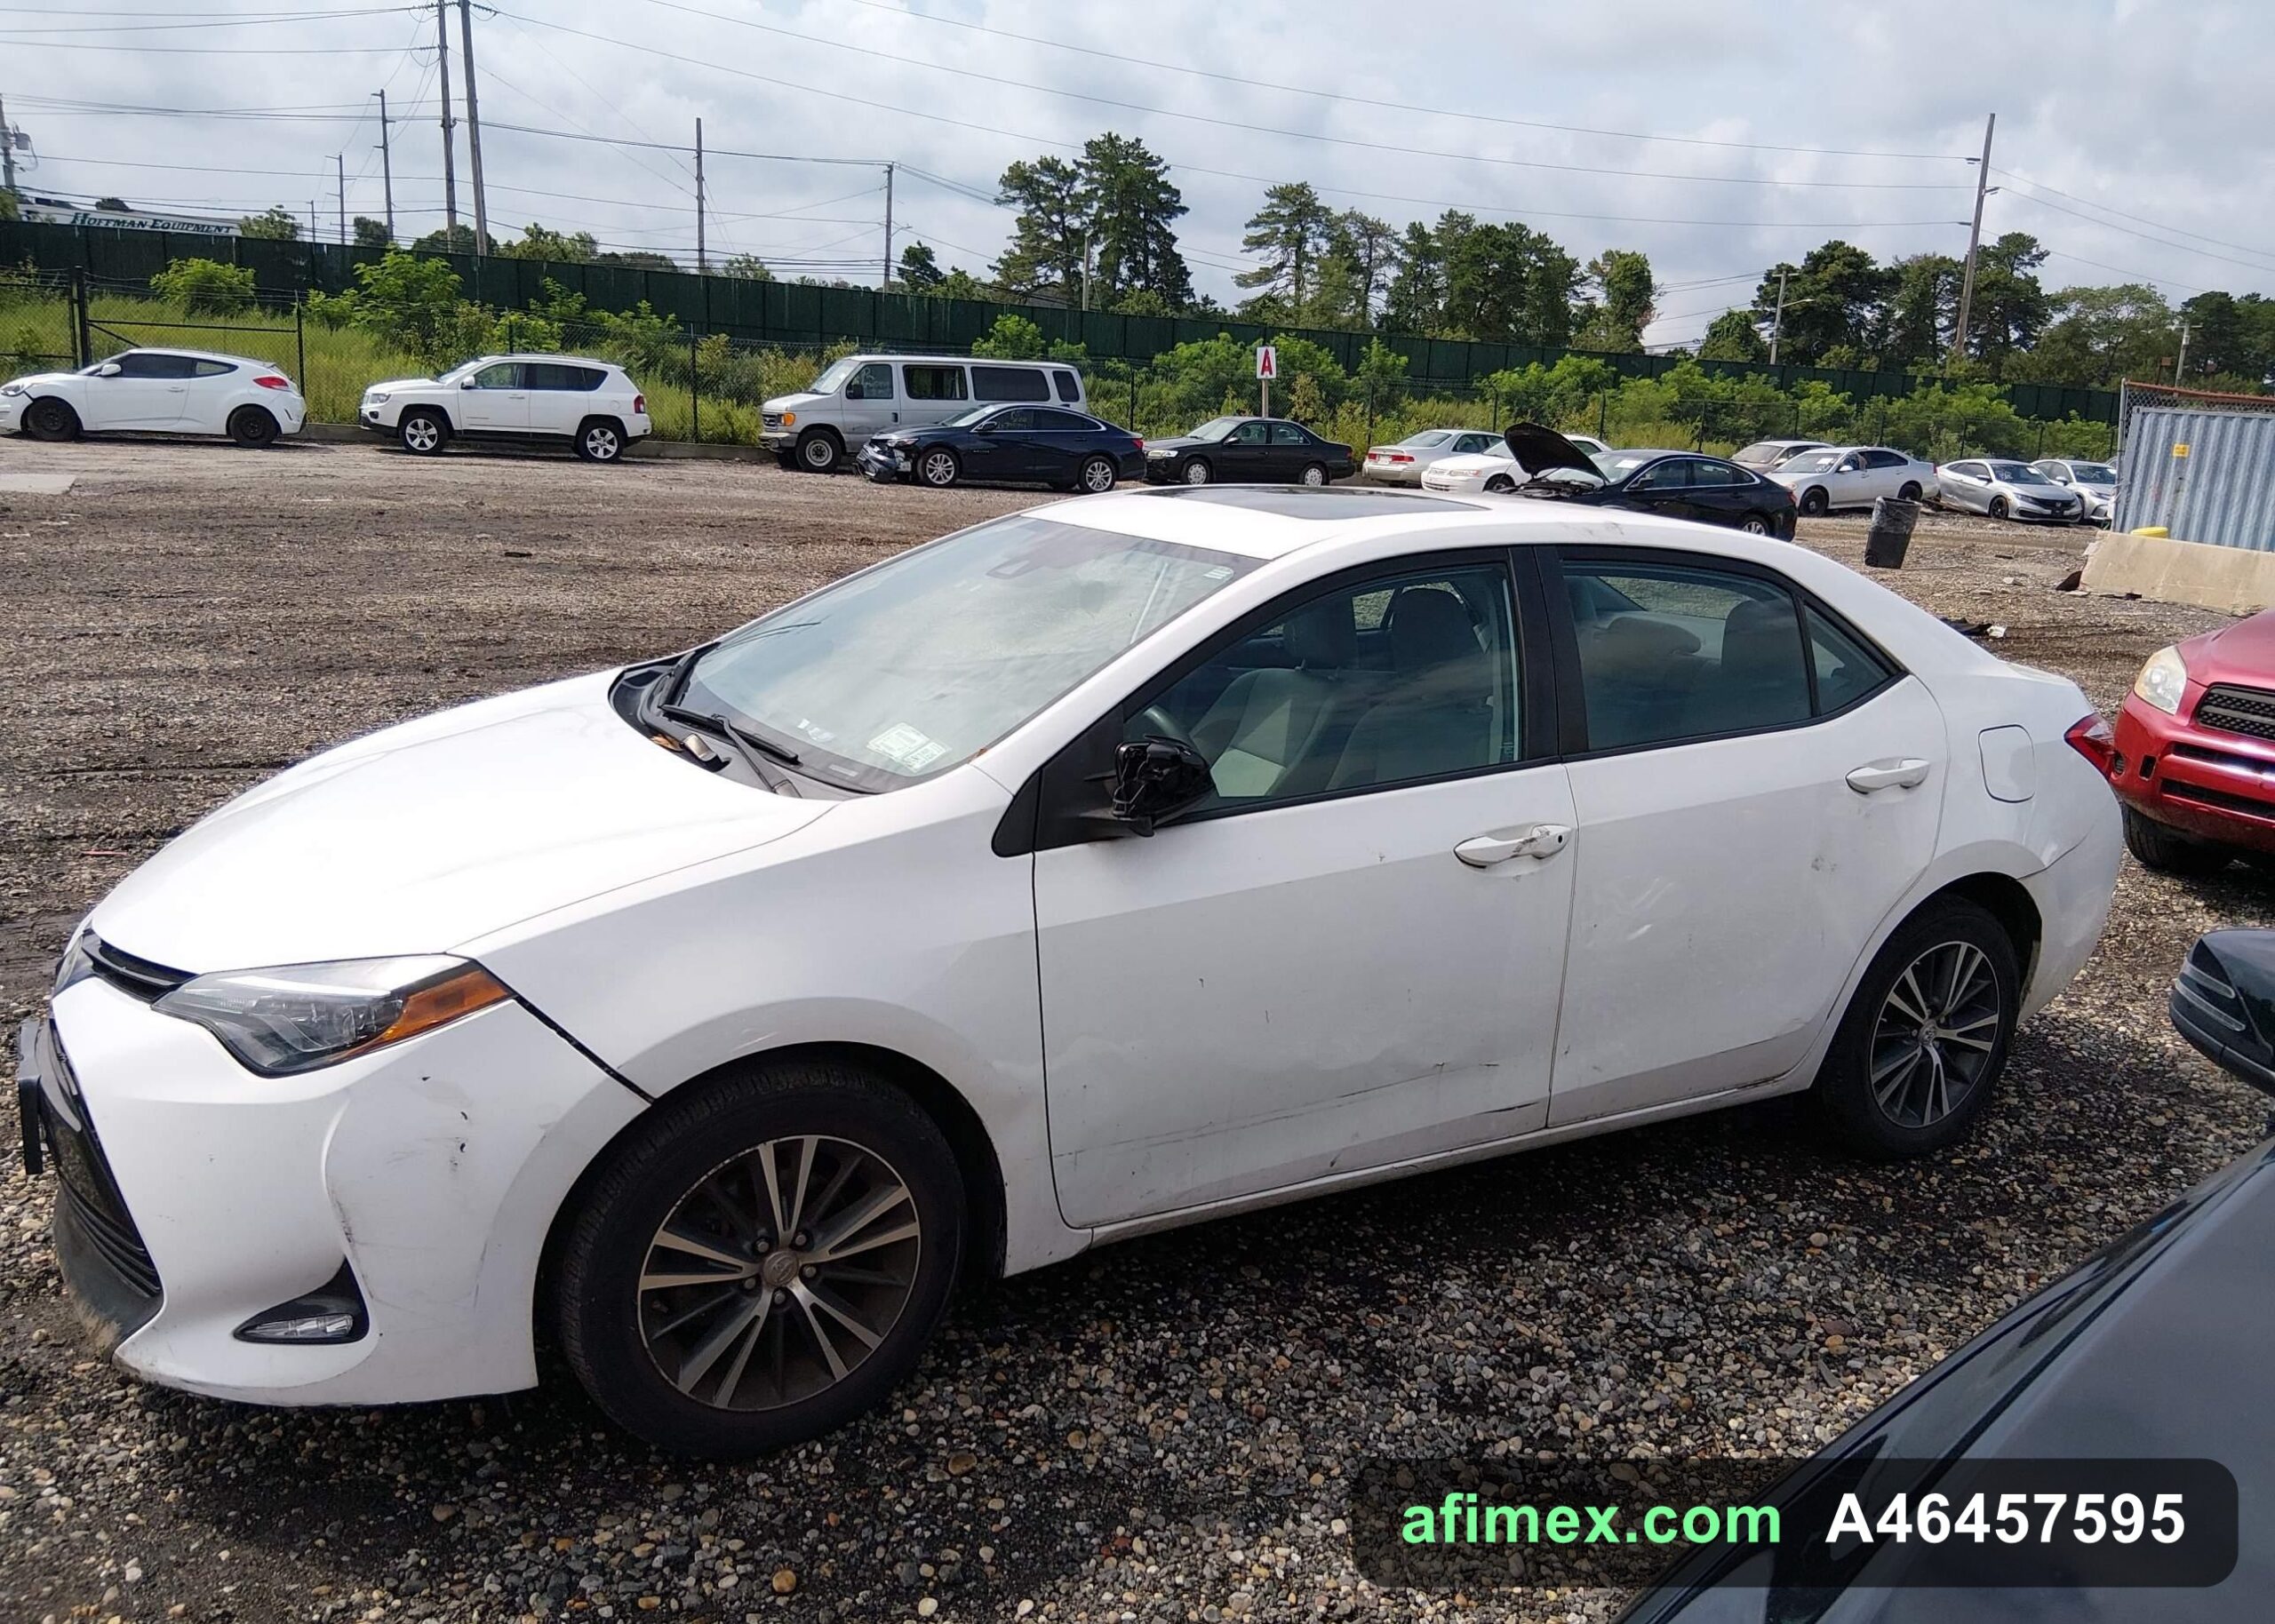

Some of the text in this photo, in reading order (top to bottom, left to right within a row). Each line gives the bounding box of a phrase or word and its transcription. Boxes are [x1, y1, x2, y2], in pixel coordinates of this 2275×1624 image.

[70, 212, 234, 234] HOFFMAN EQUIPMENT
[1260, 347, 1273, 376] A
